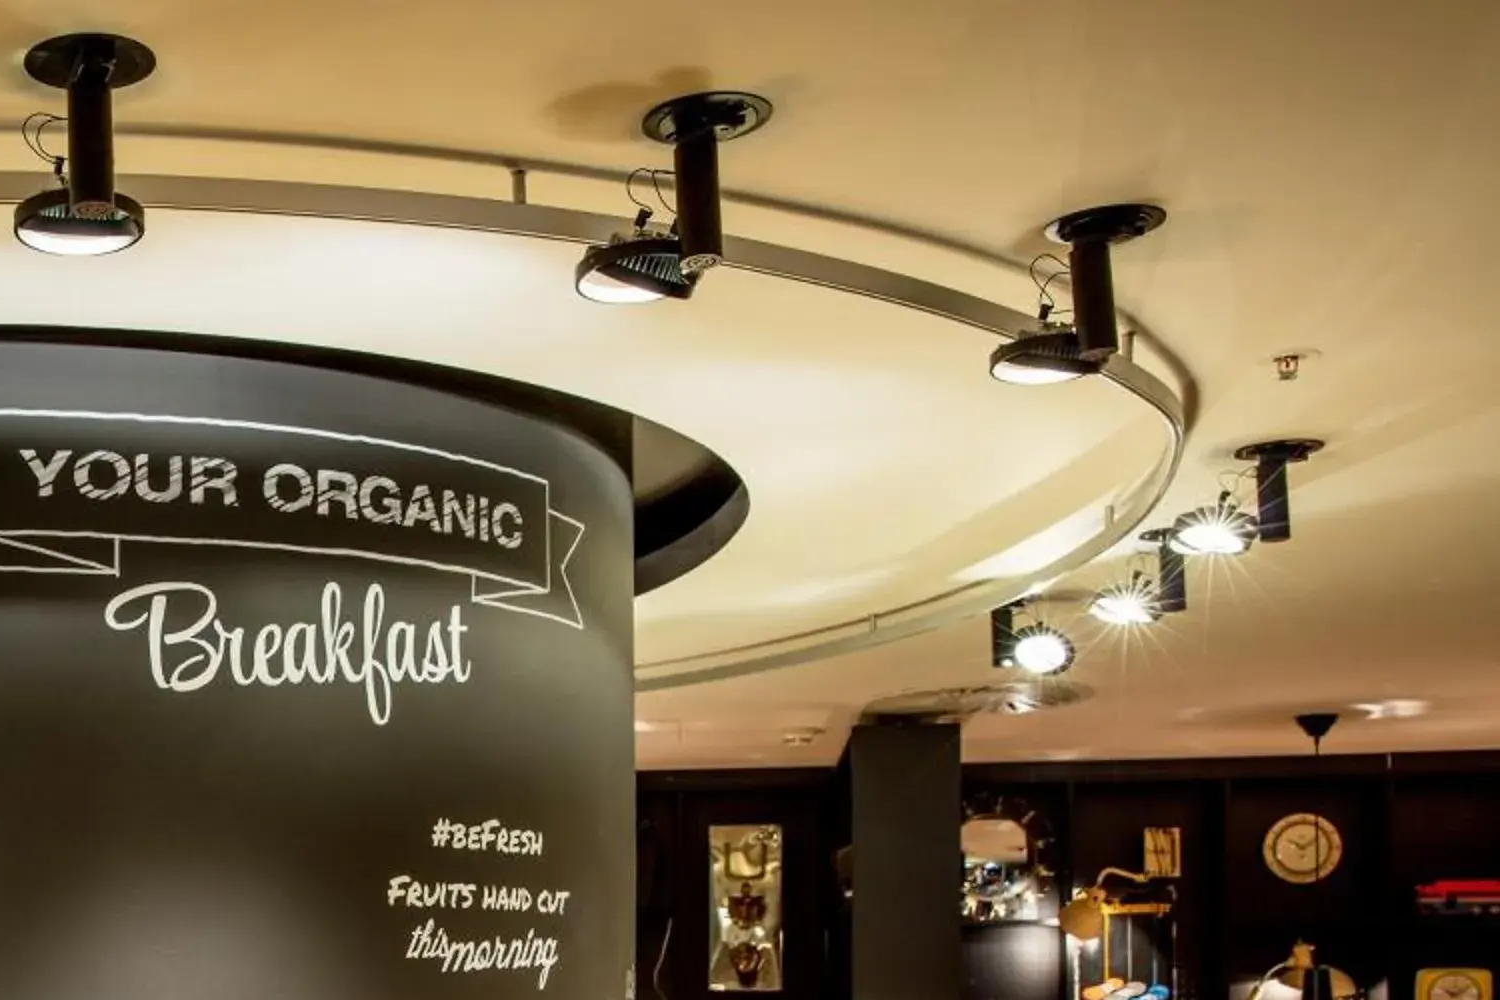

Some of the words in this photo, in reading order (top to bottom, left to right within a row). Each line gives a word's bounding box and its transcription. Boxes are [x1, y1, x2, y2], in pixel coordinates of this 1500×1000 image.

[19, 449, 239, 507] YOUR
[263, 462, 524, 549] ORGANIC
[105, 581, 472, 725] Breakfast
[388, 875, 477, 909] FRUITS
[481, 885, 533, 912] HAND
[537, 890, 571, 915] CUT
